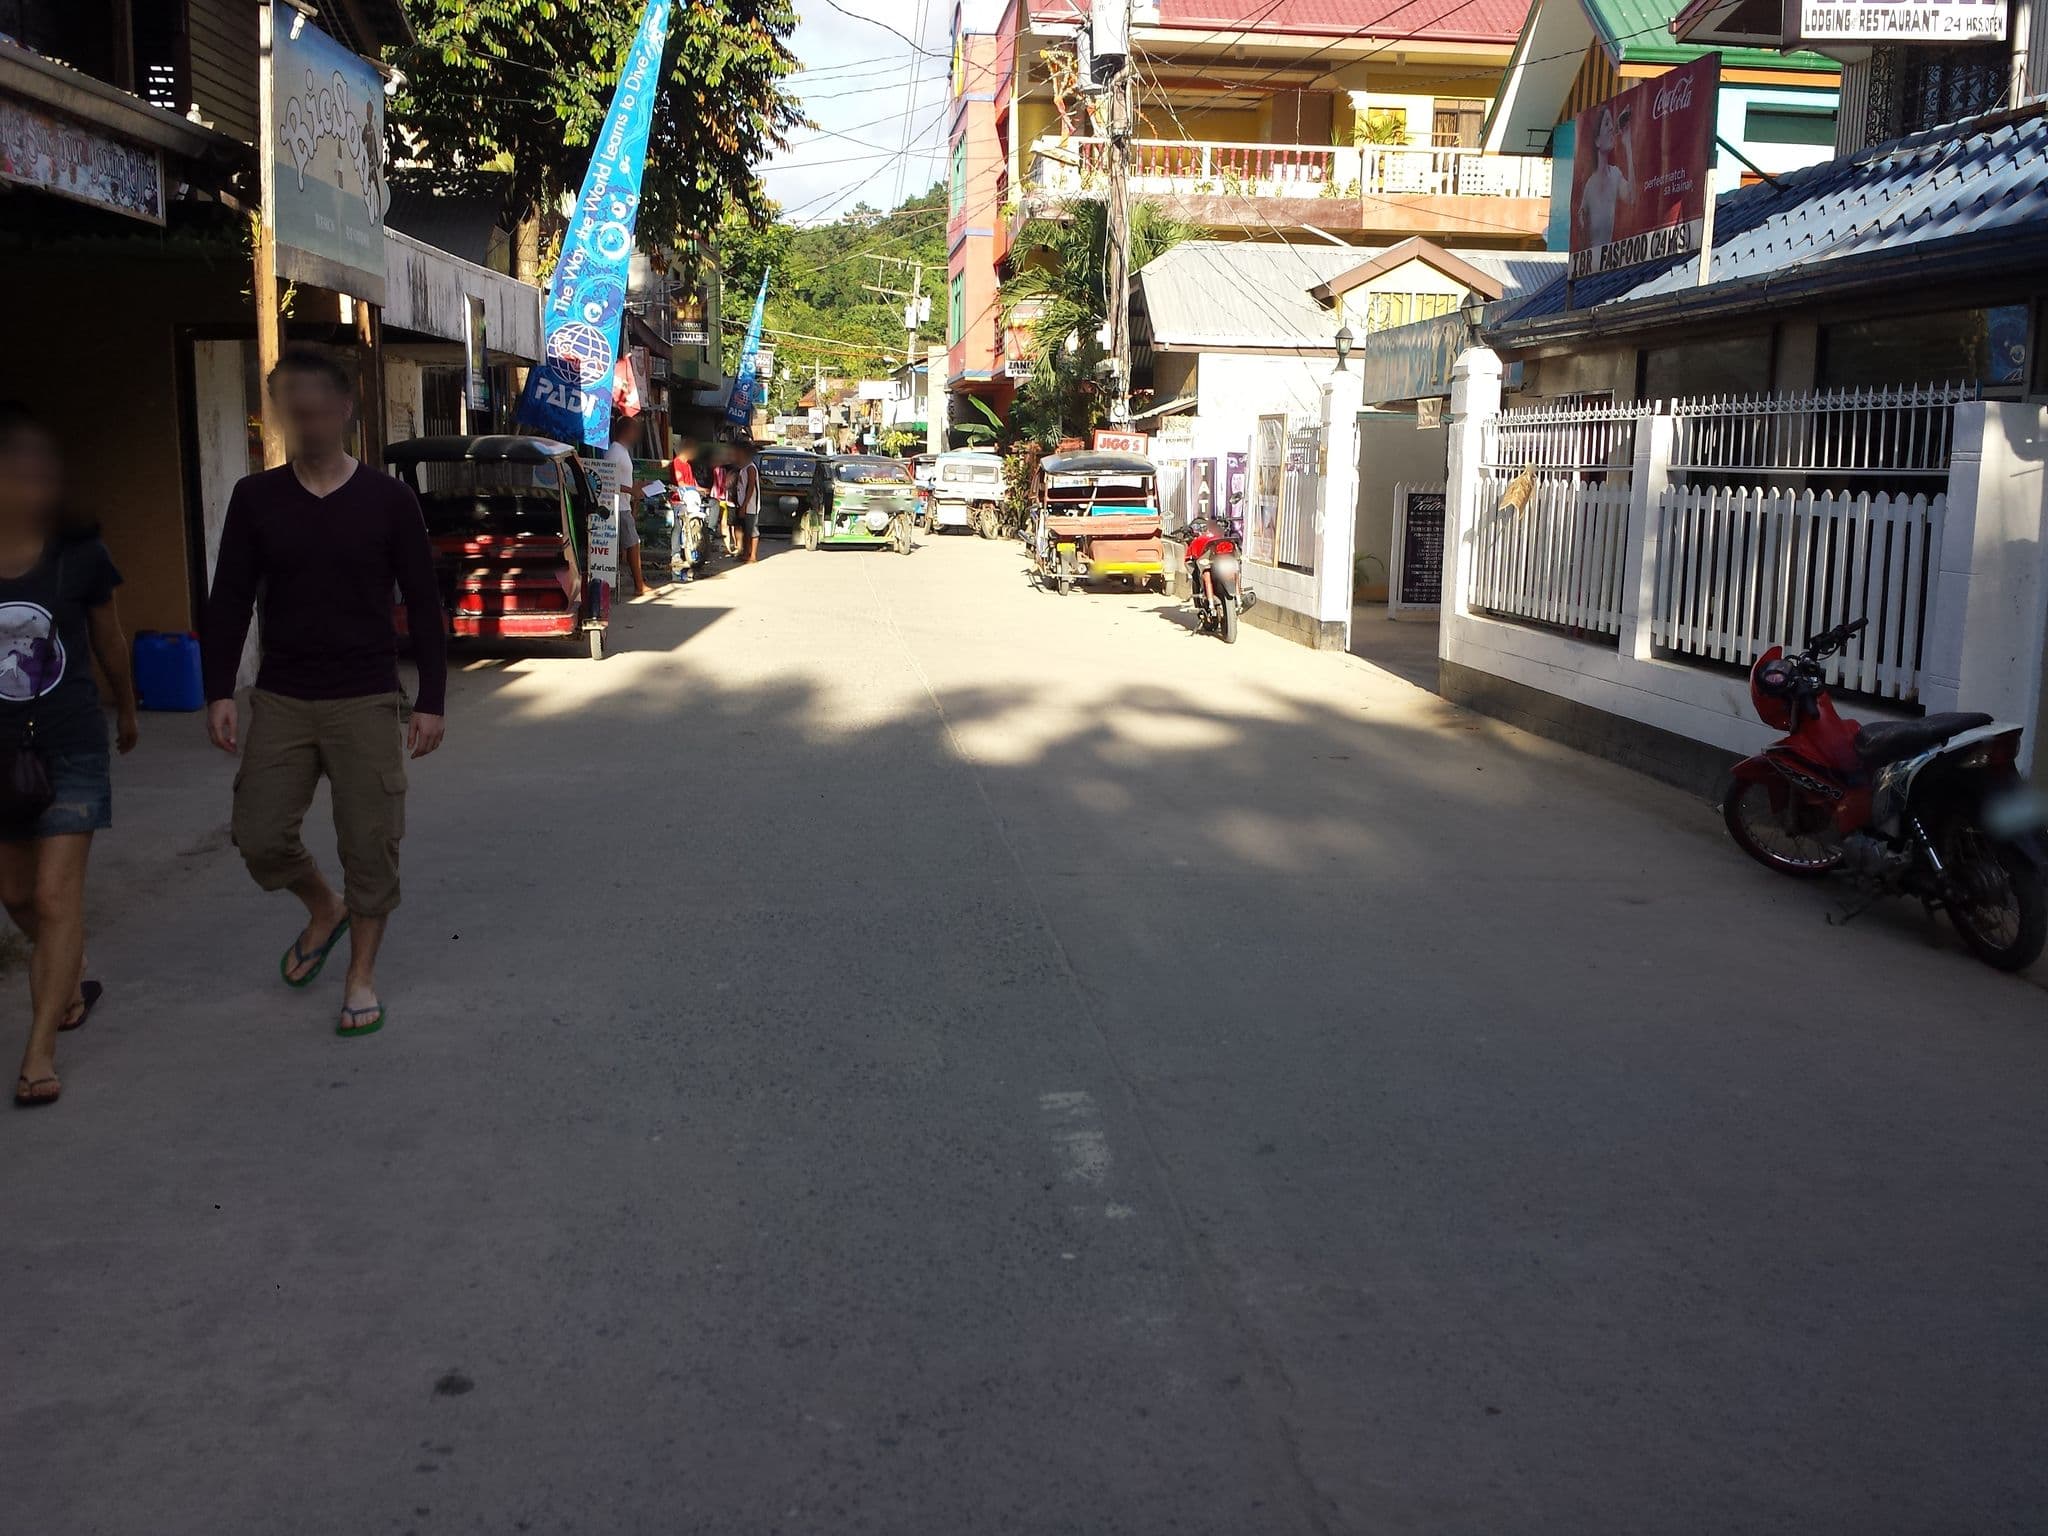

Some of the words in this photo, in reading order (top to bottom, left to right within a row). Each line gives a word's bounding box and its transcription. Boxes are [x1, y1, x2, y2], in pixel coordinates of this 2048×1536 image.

[1804, 9, 1851, 32] LODGING
[1858, 9, 1940, 32] RESTAURANT
[1944, 16, 1961, 32] 24
[625, 55, 650, 91] Dive
[619, 94, 636, 111] to
[58, 129, 83, 173] Tour
[601, 113, 630, 162] Learns
[583, 162, 612, 216] World
[575, 217, 595, 246] the
[562, 247, 588, 283] Way
[1600, 234, 1648, 271] FASFOOD
[553, 286, 574, 313] The
[535, 378, 599, 418] PADI
[728, 406, 747, 418] PADI
